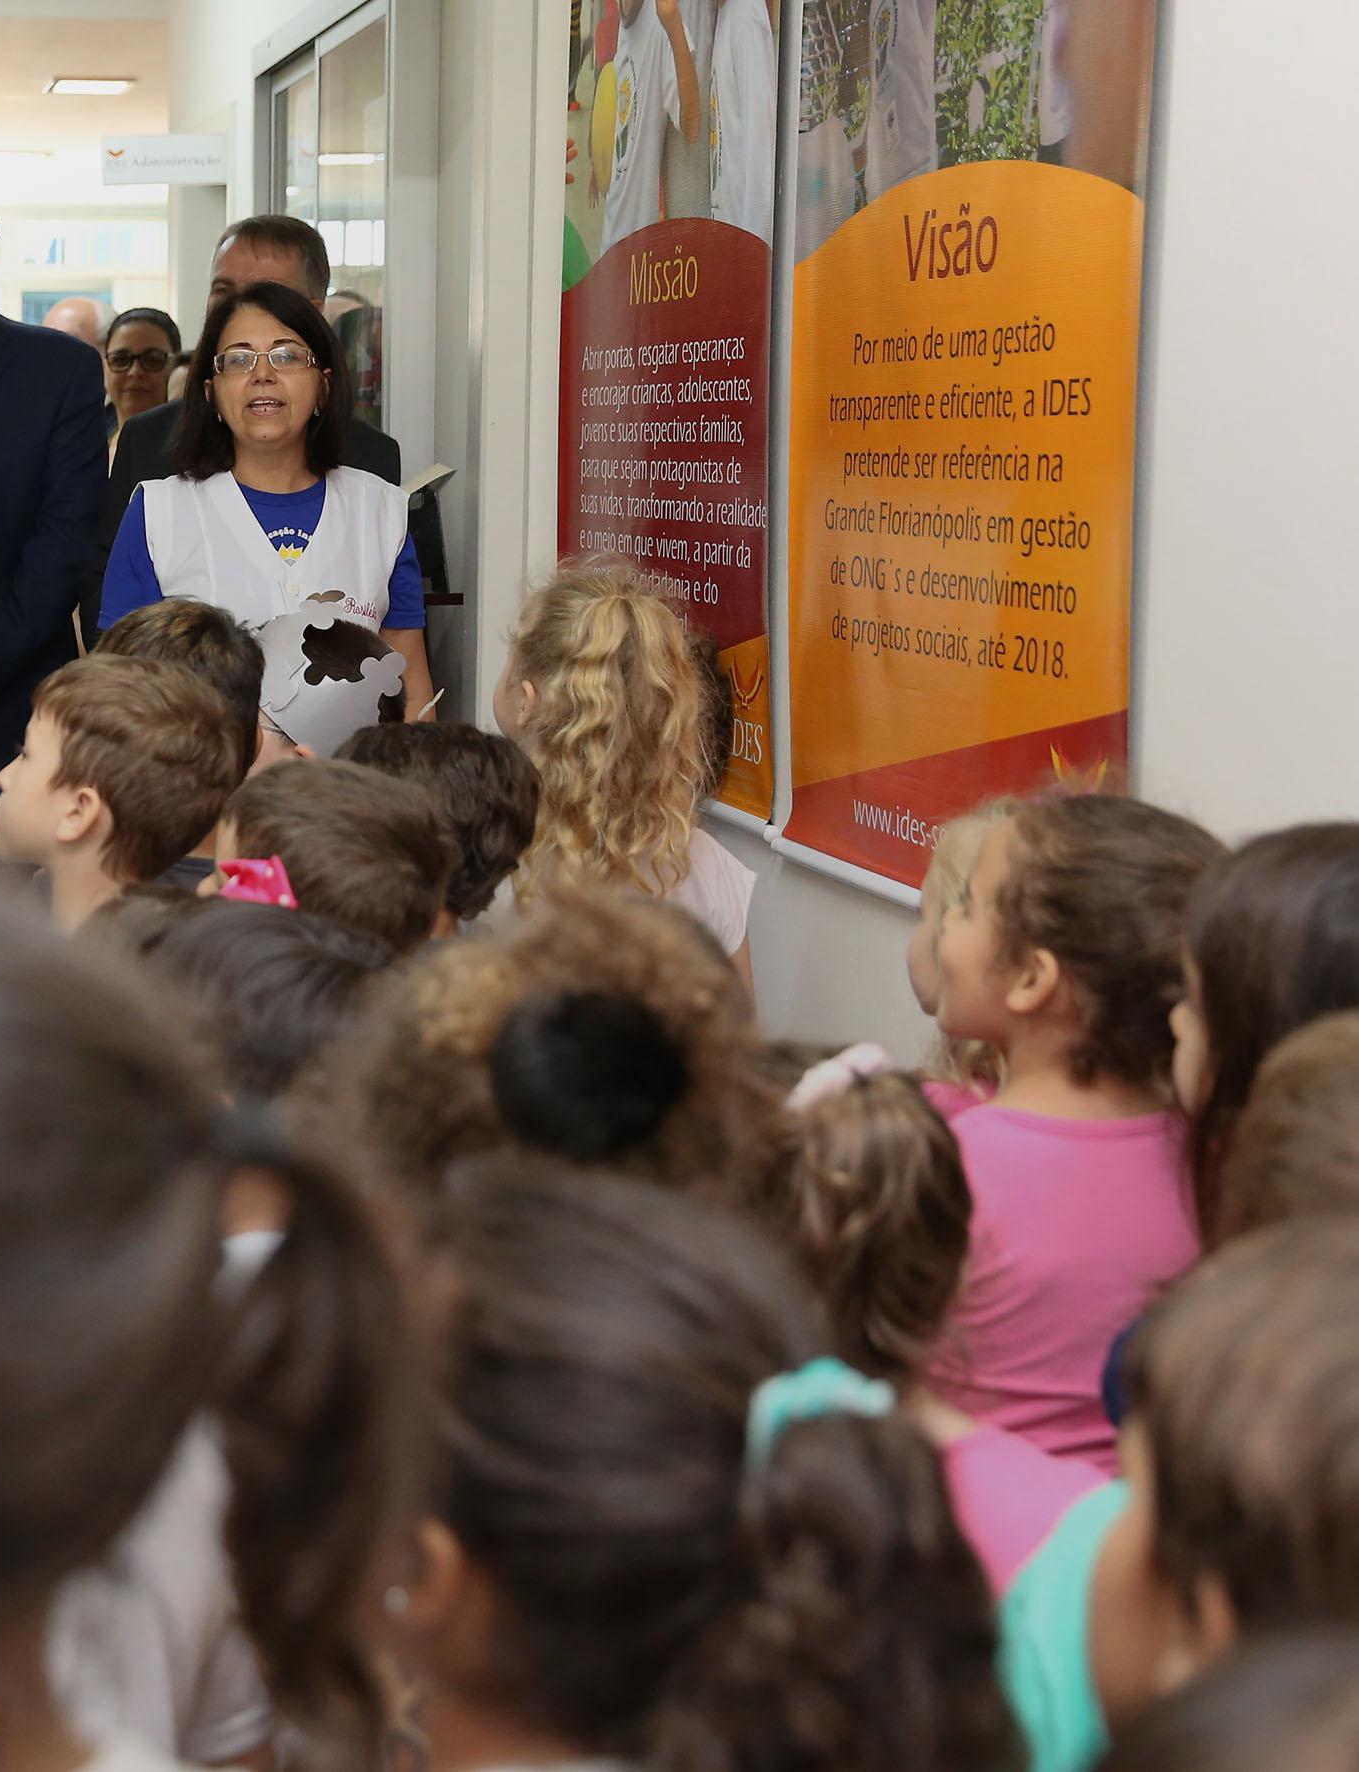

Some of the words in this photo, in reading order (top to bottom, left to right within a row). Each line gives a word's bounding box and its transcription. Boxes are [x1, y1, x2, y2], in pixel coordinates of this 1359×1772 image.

[903, 202, 998, 282] Visão
[629, 245, 698, 305] Missão
[582, 345, 604, 371] Abrir
[605, 344, 635, 376] portas,
[638, 340, 679, 374] resgatar
[682, 336, 745, 370] esperanças
[854, 333, 878, 365] Por
[882, 328, 918, 363] meio
[923, 326, 944, 361] de
[949, 327, 987, 358] uma
[993, 314, 1055, 367] gestão
[582, 387, 587, 406] e
[590, 380, 630, 413] encorajar
[632, 378, 675, 410] crianças,
[677, 375, 753, 405] adolescentes,
[829, 390, 920, 430] transparente
[925, 394, 935, 419] e
[939, 383, 1017, 422] eficiente,
[1023, 388, 1035, 418] a
[1043, 377, 1092, 417] IDES
[580, 418, 608, 449] jovens
[610, 424, 616, 442] e
[618, 421, 638, 442] suas
[640, 416, 696, 450] respectivas
[700, 413, 745, 446] famílias,
[580, 458, 599, 485] para
[601, 459, 619, 485] que
[620, 455, 648, 487] sejam
[649, 455, 724, 490] protagonistas
[726, 456, 742, 484] de
[843, 445, 910, 486] pretende
[914, 452, 938, 479] ser
[943, 444, 1029, 482] referência
[1036, 452, 1063, 482] na
[580, 493, 598, 514] suas
[599, 490, 625, 519] vidas,
[627, 492, 704, 523] transformando
[706, 501, 714, 523] a
[716, 497, 767, 528] realidade
[825, 498, 875, 534] Grande
[879, 501, 982, 549] Florianópolis
[986, 514, 1013, 544] em
[1021, 510, 1091, 557] gestão
[580, 529, 585, 548] e
[587, 530, 593, 549] o
[594, 526, 616, 552] meio
[618, 534, 632, 554] em
[634, 536, 653, 562] que
[656, 532, 690, 564] vivem,
[693, 541, 701, 562] a
[703, 538, 734, 571] partir
[736, 539, 751, 569] da
[693, 580, 701, 602] e
[703, 577, 719, 604] do
[831, 555, 846, 586] de
[906, 569, 915, 595] e
[920, 564, 1077, 615] desenvolvimento
[832, 609, 847, 641] de
[851, 615, 911, 657] projetos
[915, 624, 971, 667] sociais,
[978, 633, 1006, 669] até
[1013, 635, 1068, 679] 2018.
